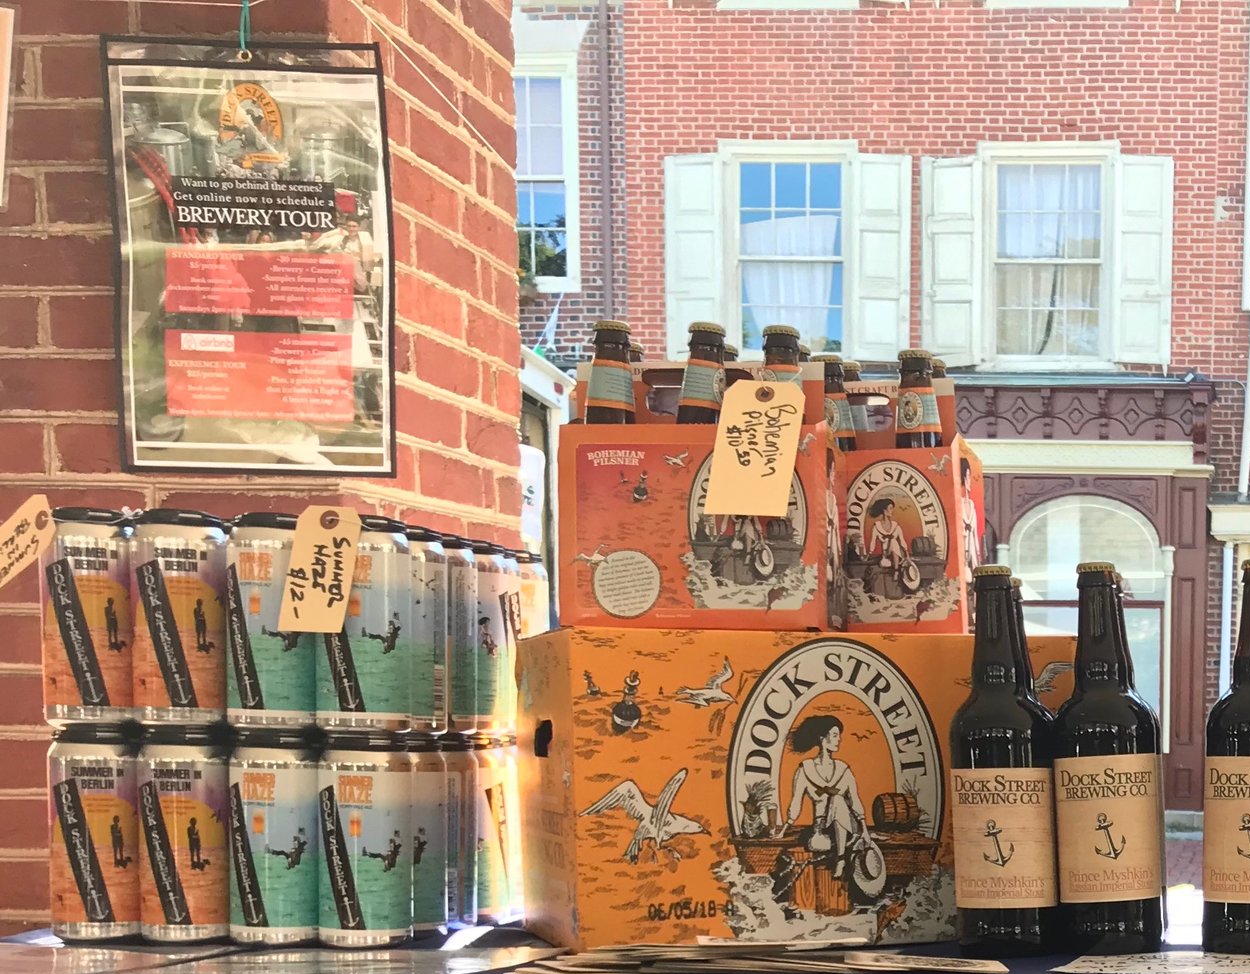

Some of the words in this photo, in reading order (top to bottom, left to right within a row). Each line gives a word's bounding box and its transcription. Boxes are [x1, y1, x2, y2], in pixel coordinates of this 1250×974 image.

[181, 178, 207, 188] Want
[209, 179, 219, 188] to
[222, 181, 234, 190] go
[235, 180, 269, 190] behind
[271, 182, 286, 191] the
[289, 183, 322, 193] scenes?
[173, 191, 192, 201] Get
[196, 192, 232, 202] online
[235, 195, 258, 204] now
[262, 195, 273, 204] to
[277, 195, 324, 207] schedule
[177, 206, 273, 226] BREWERY
[275, 210, 335, 229] TOUR
[586, 450, 646, 461] BOHEMIAN
[593, 458, 640, 467] PILSNER
[847, 472, 880, 532] DOCK
[883, 466, 940, 530] STREET
[52, 563, 72, 606] DOCK
[142, 565, 162, 607] DOCK
[64, 609, 91, 672] STREET
[155, 610, 179, 673] STREET
[744, 662, 819, 777] DOCK
[823, 652, 928, 778] STREET
[71, 766, 114, 778] SUMMER
[1060, 770, 1101, 788] DOCK
[1103, 767, 1153, 785] STREET
[1210, 768, 1249, 786] DOCK
[81, 779, 115, 790] BERLIN
[159, 780, 192, 792] BERLIN
[954, 774, 991, 793] DOCK
[994, 774, 1047, 793] STREET
[1065, 784, 1127, 800] BREWING
[1129, 783, 1148, 797] CO.
[60, 782, 79, 826] DOCK
[958, 792, 1018, 805] BREWING
[1020, 792, 1041, 805] CO.
[322, 790, 335, 832] DOCK
[151, 830, 174, 891] STREET
[235, 832, 251, 893] STREET
[329, 835, 349, 896] STREET
[1069, 870, 1101, 883] Prince
[1103, 867, 1154, 885] Myshkin's
[1210, 869, 1241, 882] Prince
